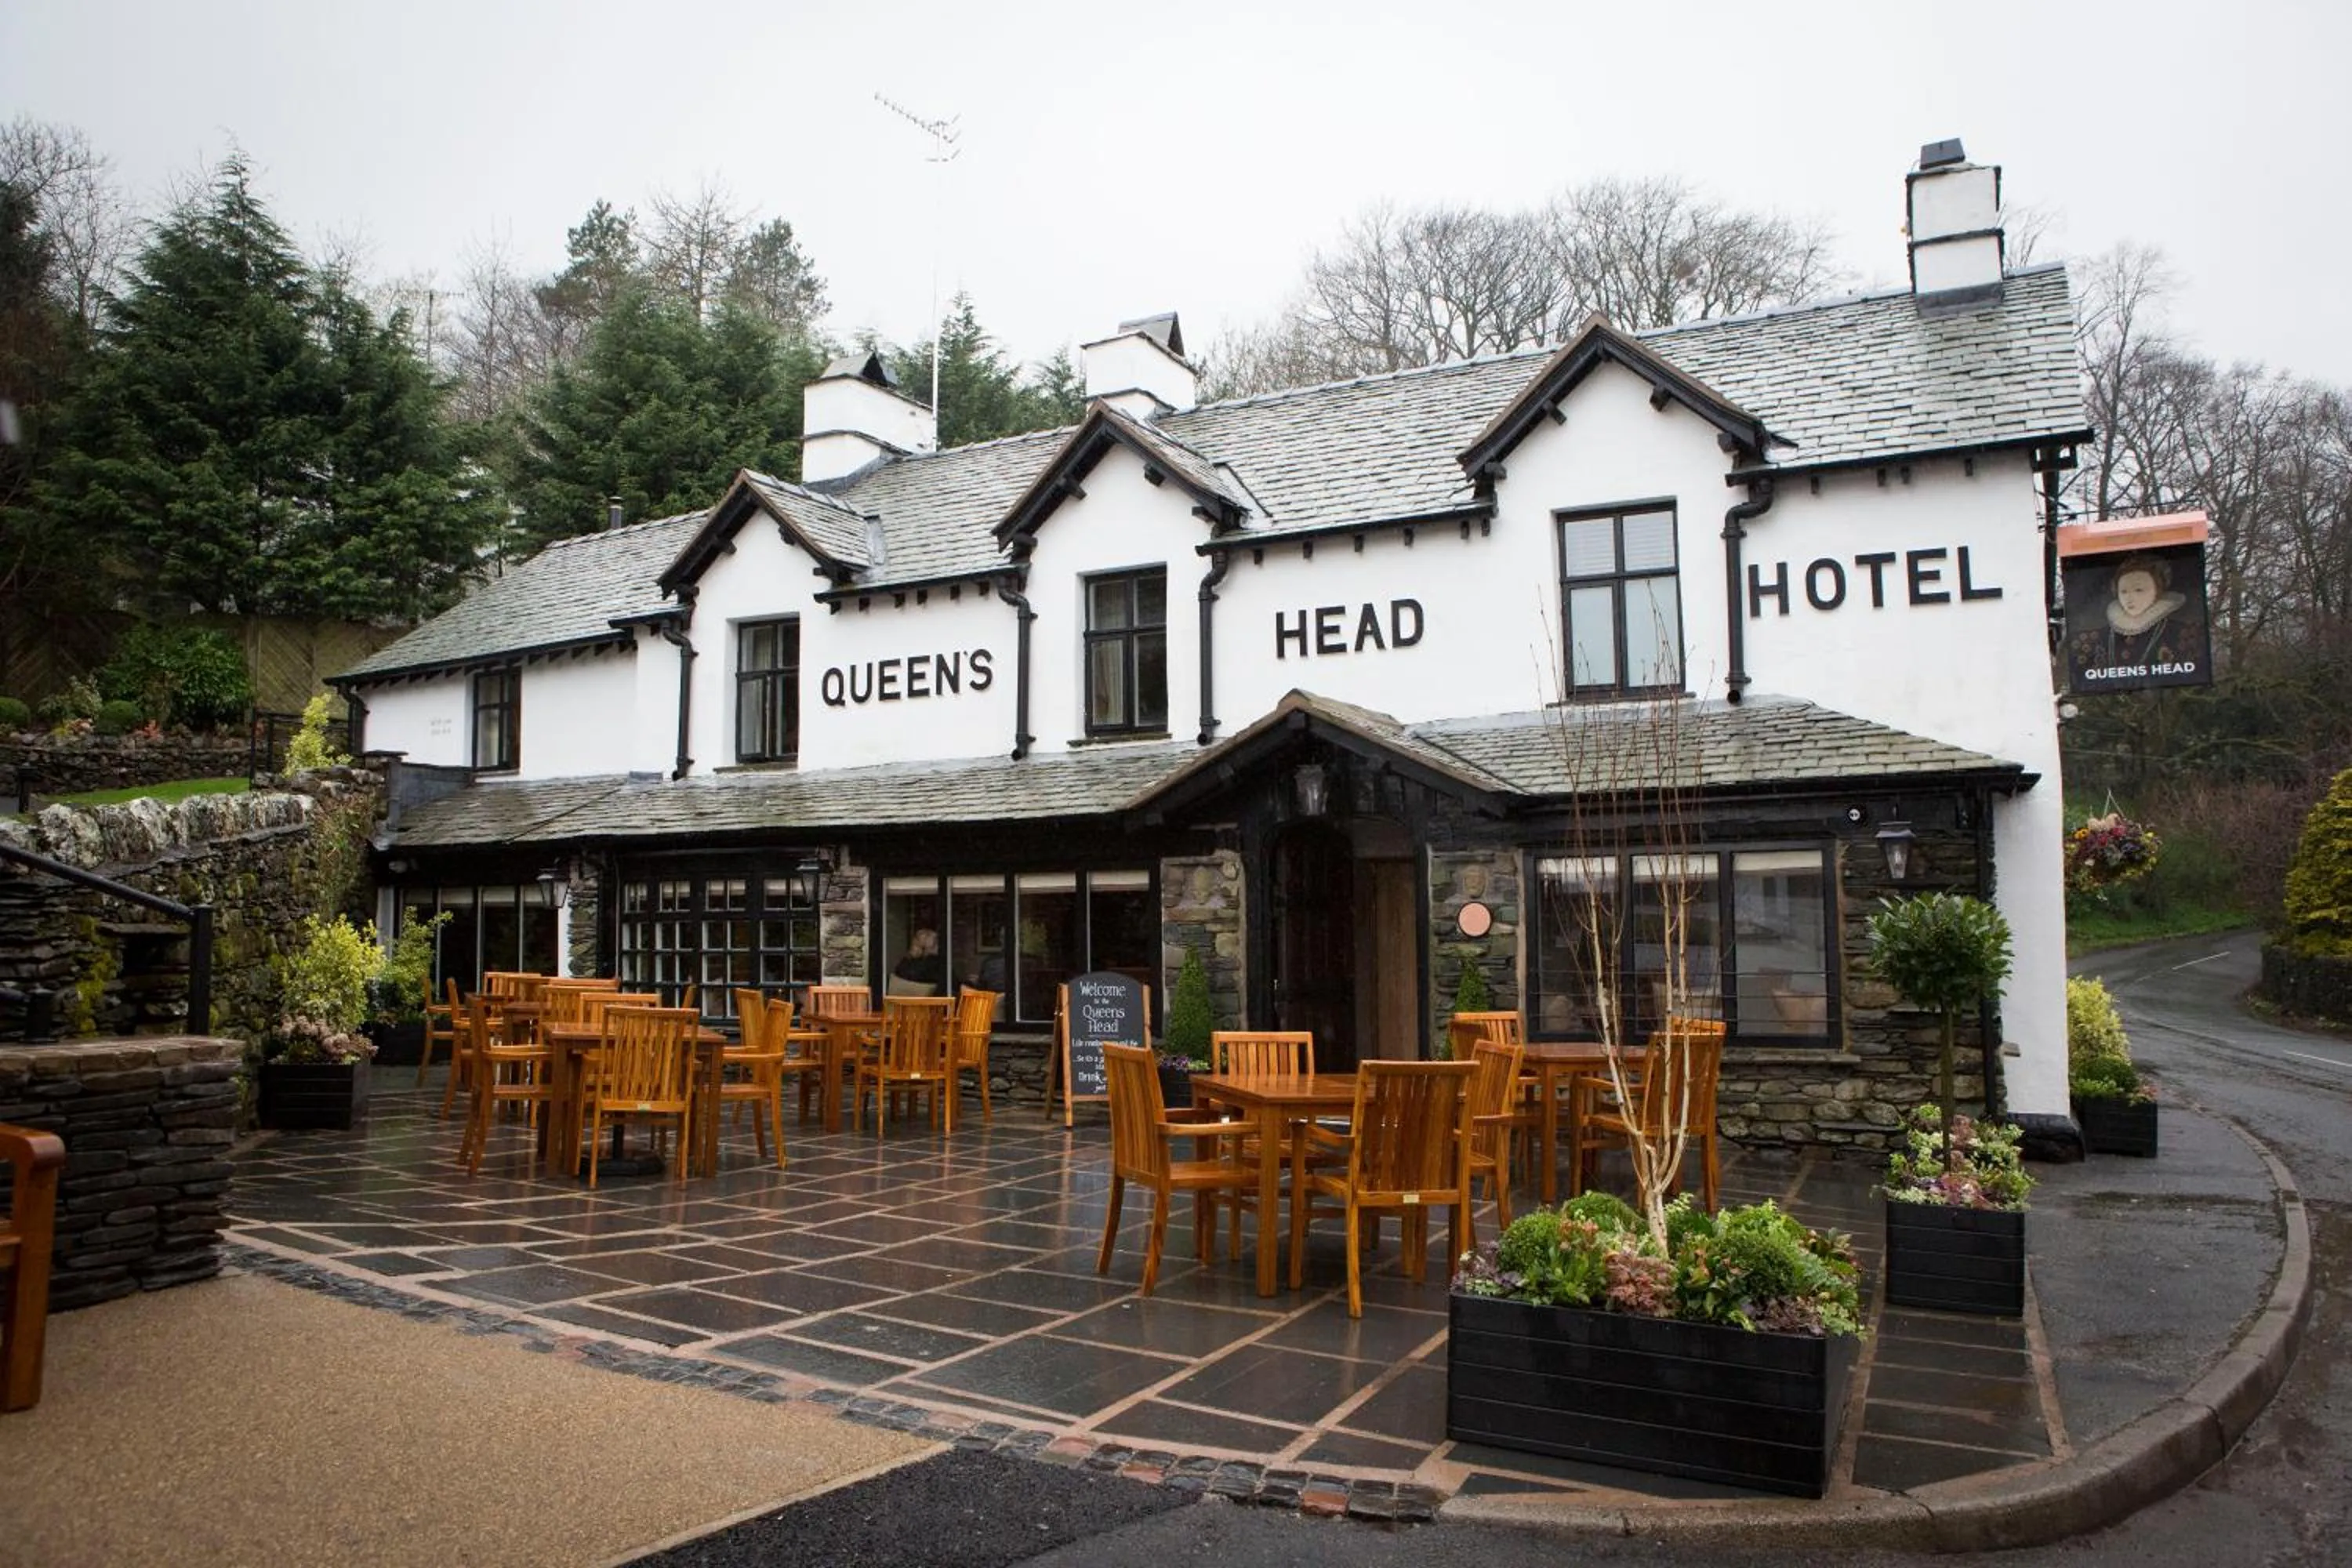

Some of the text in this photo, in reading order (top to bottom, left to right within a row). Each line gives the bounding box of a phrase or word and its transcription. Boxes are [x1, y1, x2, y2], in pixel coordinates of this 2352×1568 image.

[822, 546, 2003, 706] QUEEN'S HEAD HOTEL
[2085, 662, 2196, 680] QUEENS HEAD
[1080, 981, 1127, 996] Welcome
[1083, 1004, 1125, 1020] Queens
[1088, 1019, 1119, 1033] Head
